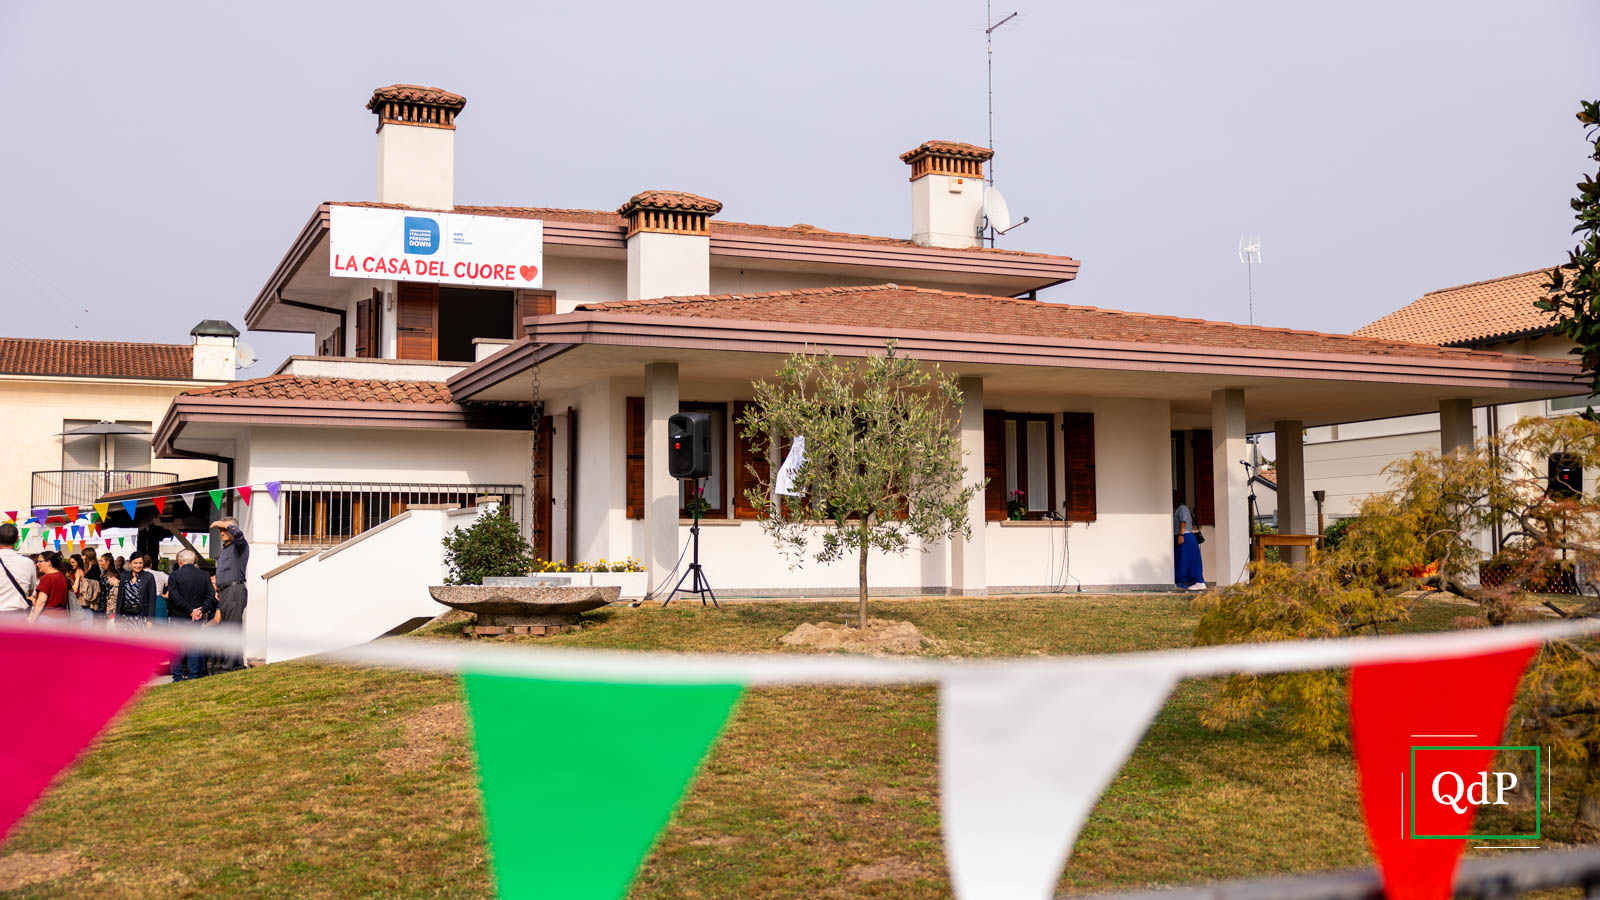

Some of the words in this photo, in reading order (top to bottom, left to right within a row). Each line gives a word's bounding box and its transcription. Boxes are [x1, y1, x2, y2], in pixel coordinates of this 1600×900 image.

[335, 254, 358, 272] LA
[363, 256, 411, 275] CASA
[415, 260, 449, 277] DEL
[454, 261, 516, 281] CUORE
